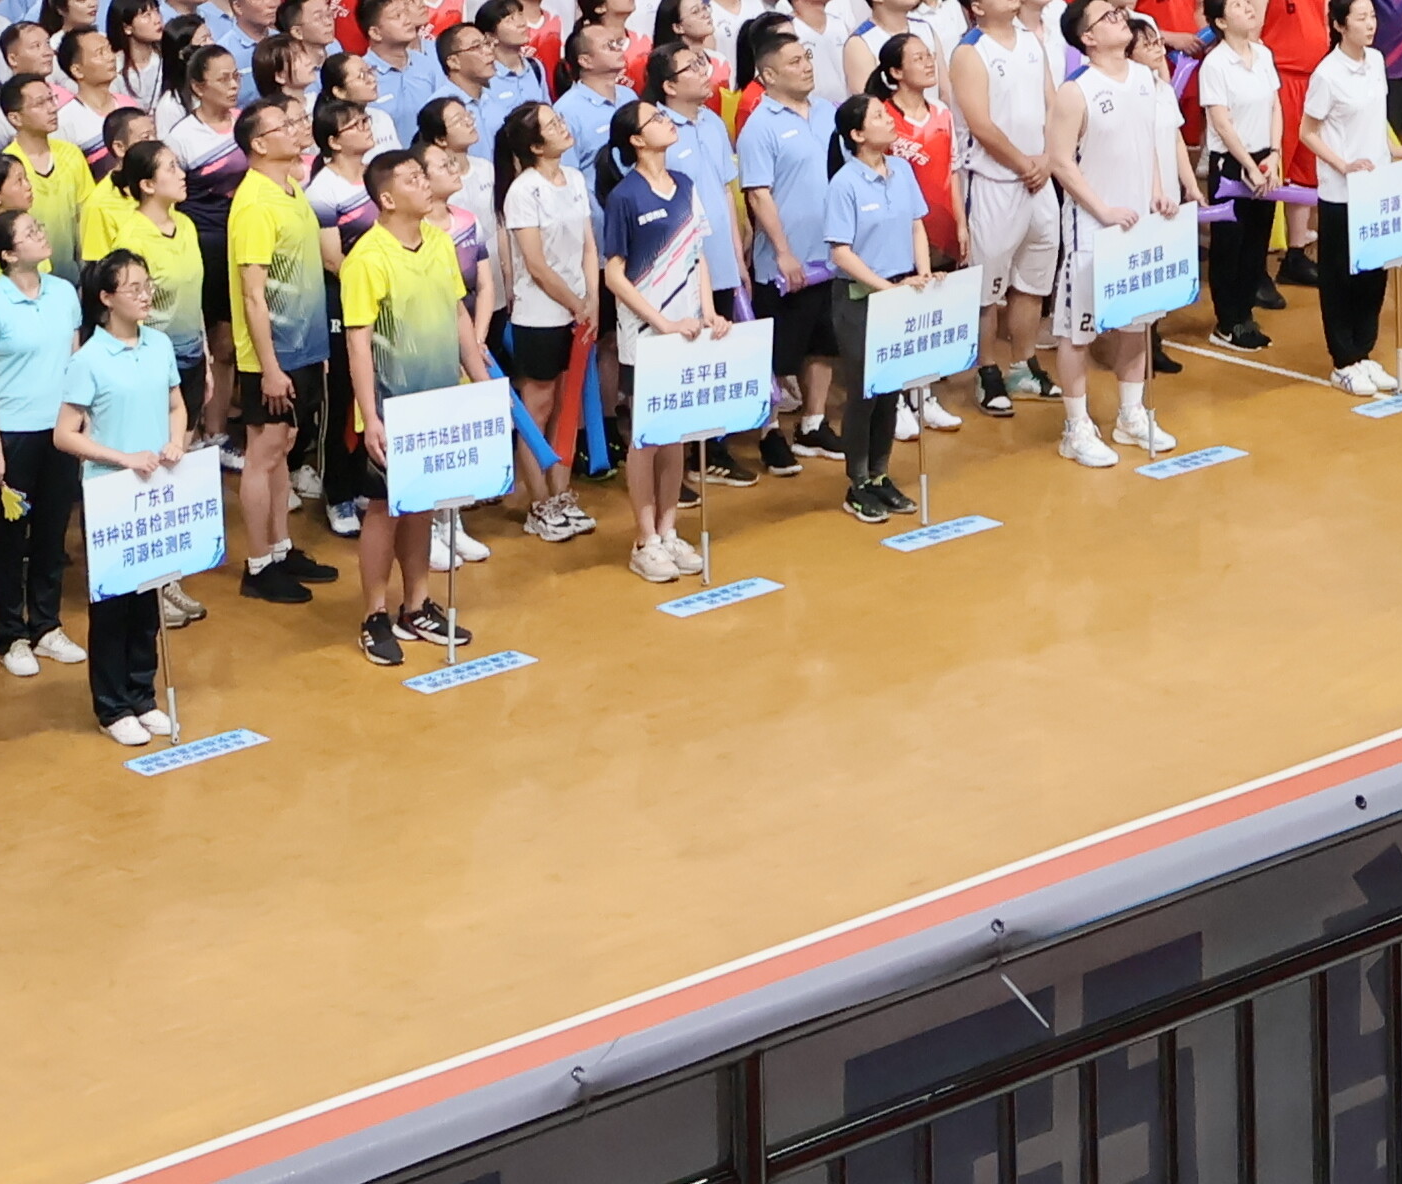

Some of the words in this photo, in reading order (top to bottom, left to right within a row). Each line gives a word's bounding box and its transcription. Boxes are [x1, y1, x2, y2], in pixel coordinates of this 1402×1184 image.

[1099, 99, 1115, 115] 23
[1128, 245, 1165, 270] 东源县
[1103, 258, 1190, 300] 市场监督管理局
[904, 309, 943, 334] 龙川县
[876, 323, 969, 364] 市场监督管理局
[680, 361, 728, 385] 连平县
[647, 379, 760, 413] 市场监督管理局
[392, 416, 507, 455] 河源市市场监督管理局
[422, 446, 480, 475] 高新区分局
[134, 483, 175, 513] 广东省
[91, 497, 220, 550] 特种设备检测研究院
[122, 530, 193, 568] 河源检测院
